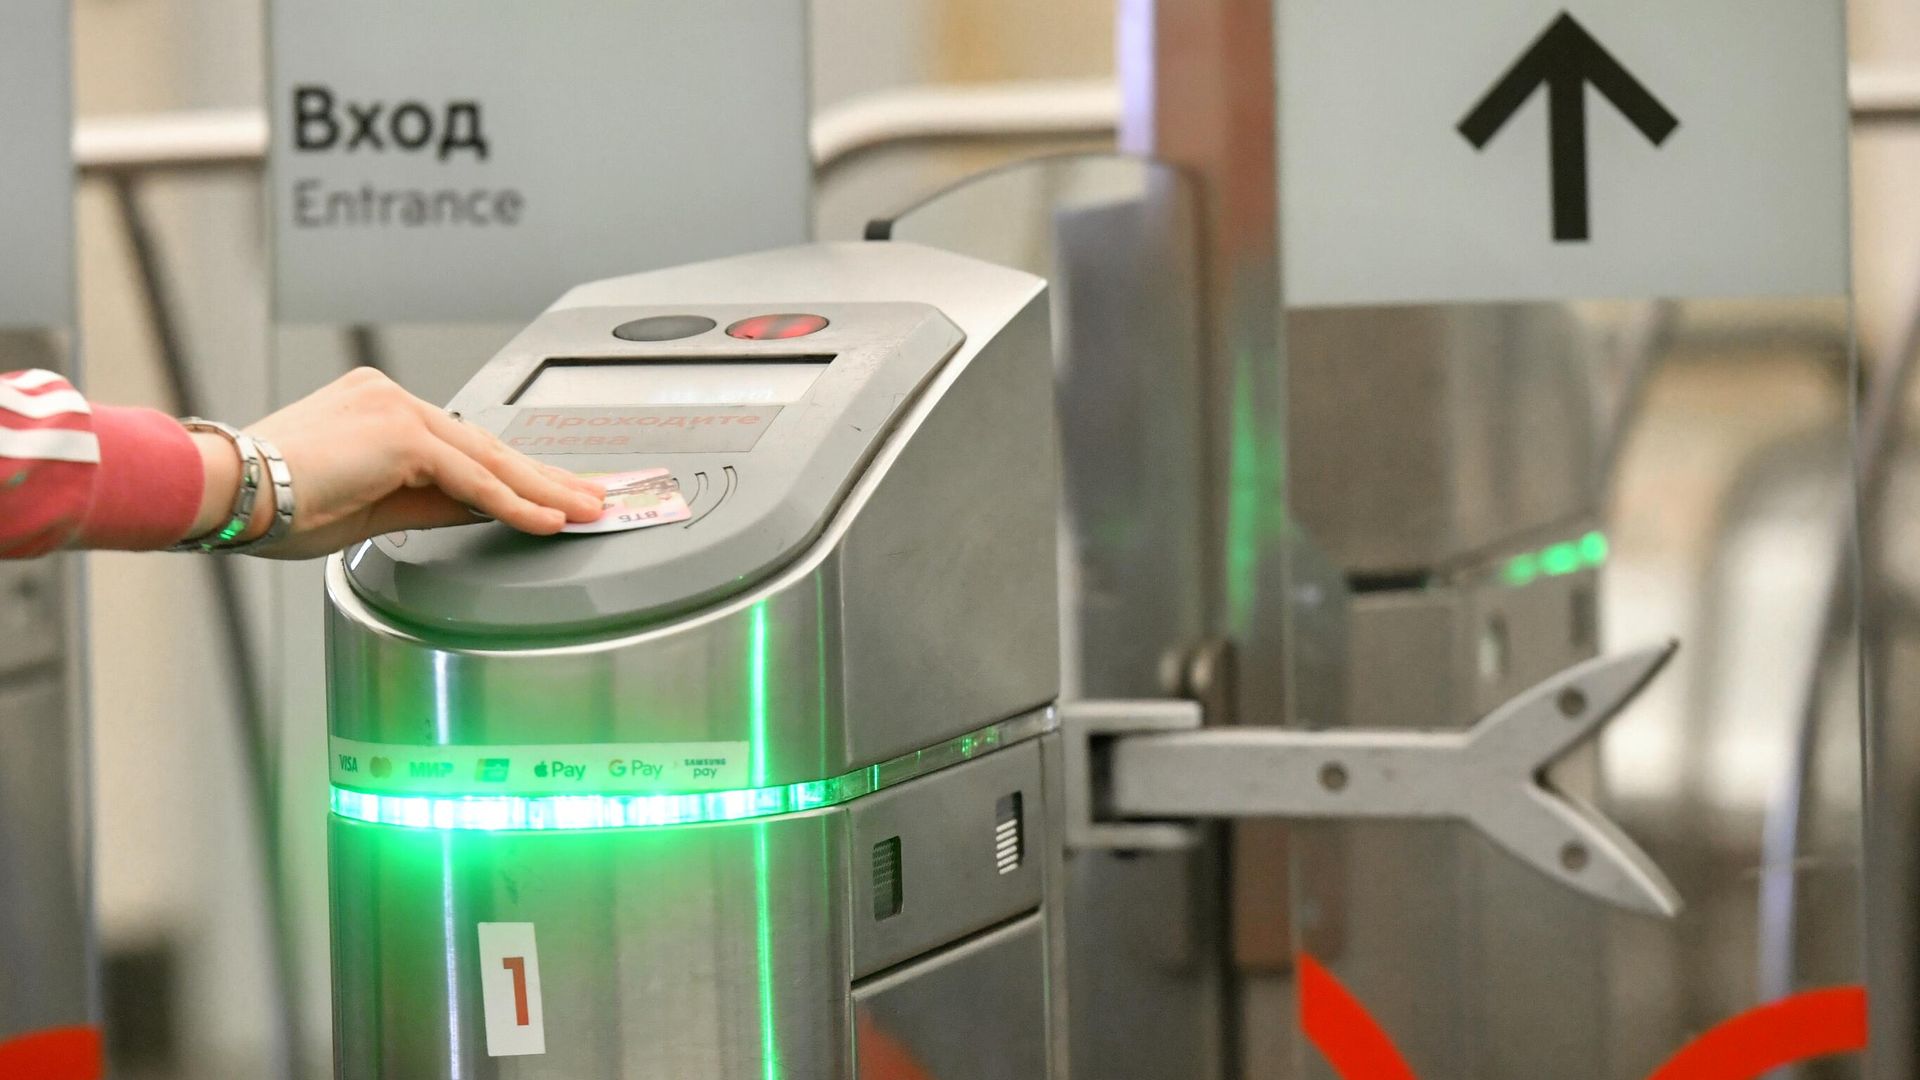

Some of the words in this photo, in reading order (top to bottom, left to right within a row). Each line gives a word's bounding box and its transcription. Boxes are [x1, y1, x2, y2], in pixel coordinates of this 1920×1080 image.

[293, 85, 490, 161] Вход
[293, 179, 525, 227] Entrance
[525, 413, 762, 430] Проходите
[508, 435, 631, 447] слева
[338, 754, 359, 773] VISA
[408, 761, 455, 778] МИР
[551, 760, 587, 781] Pay
[631, 759, 663, 779] Pay
[693, 767, 718, 779] pay
[502, 956, 530, 1026] 1
